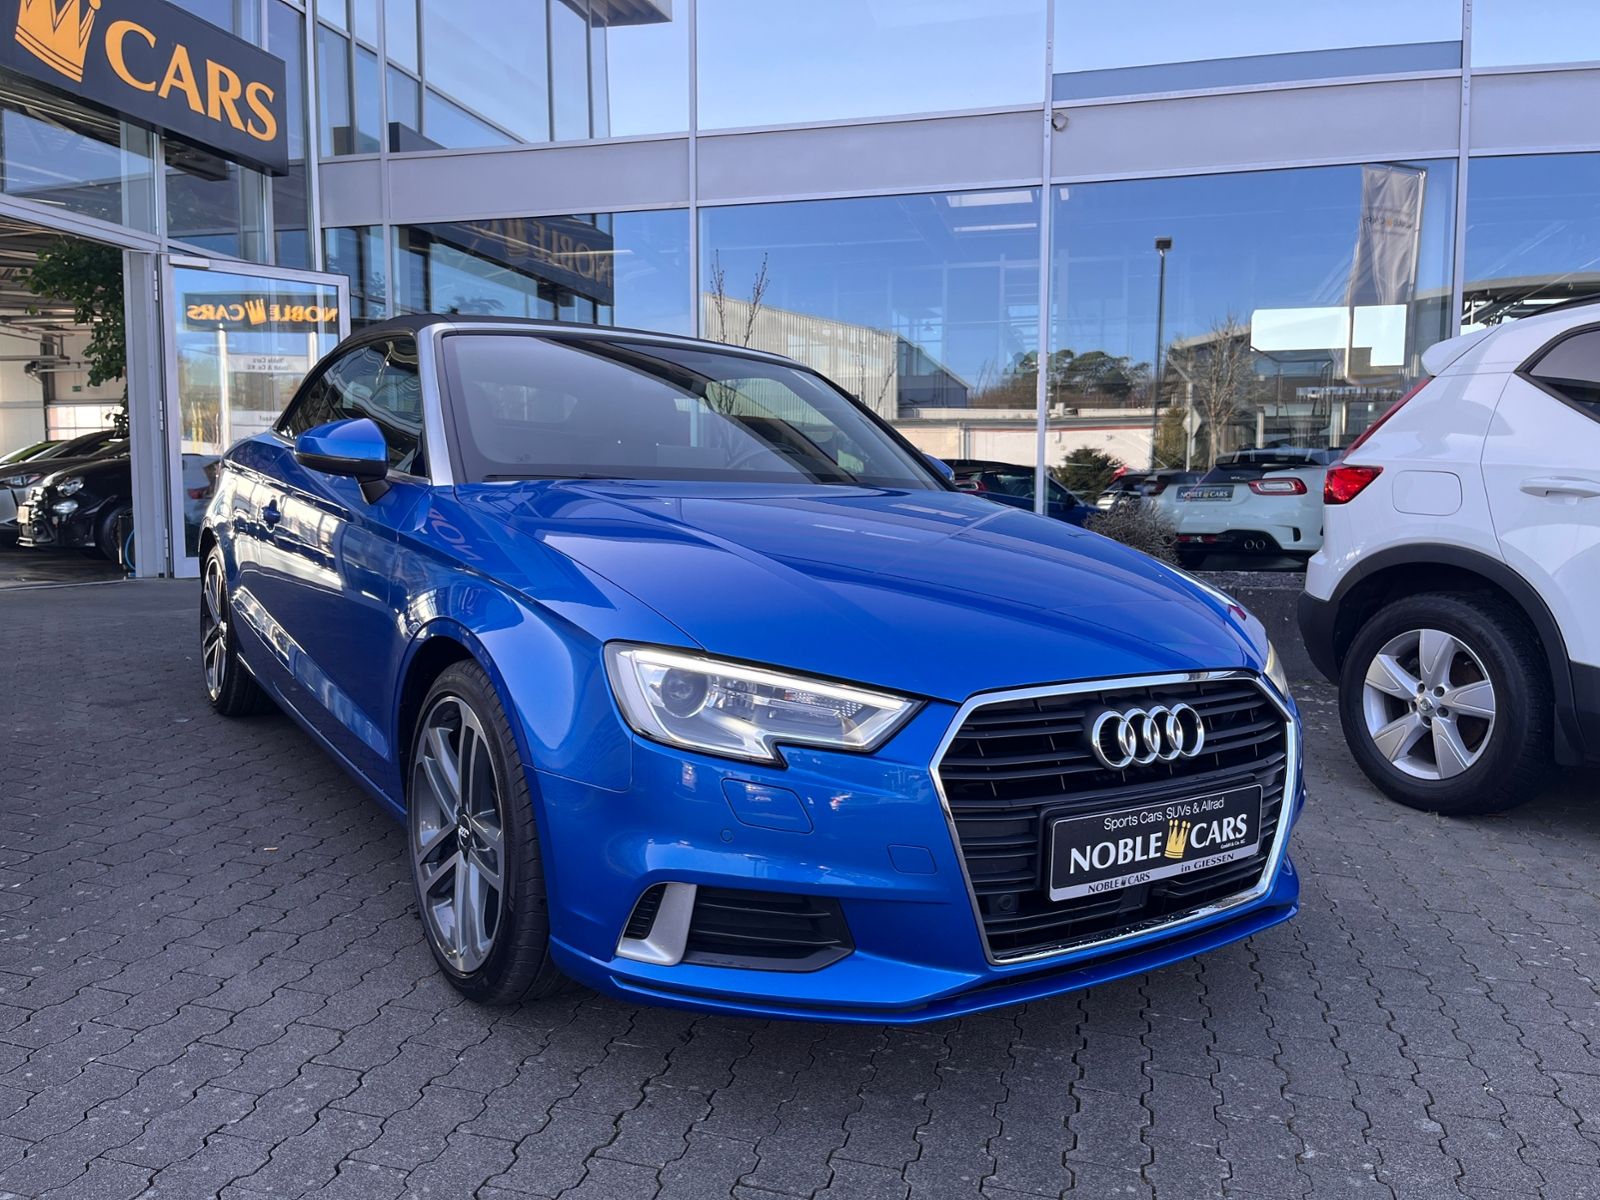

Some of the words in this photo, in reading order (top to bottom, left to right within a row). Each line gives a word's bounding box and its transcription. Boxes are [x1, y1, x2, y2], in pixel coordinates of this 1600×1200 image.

[105, 20, 277, 142] CARS
[1103, 816, 1138, 831] Sports
[1140, 811, 1165, 824] Cars,
[1166, 804, 1191, 819] SUVs
[1192, 802, 1200, 814] &
[1201, 797, 1225, 812] Allrad
[1069, 831, 1163, 874] NOBLE
[1189, 813, 1248, 849] CARS
[1180, 863, 1191, 873] in
[1193, 853, 1234, 869] GIESSEN
[1087, 877, 1119, 894] NOBLE
[1127, 872, 1151, 886] CARS
